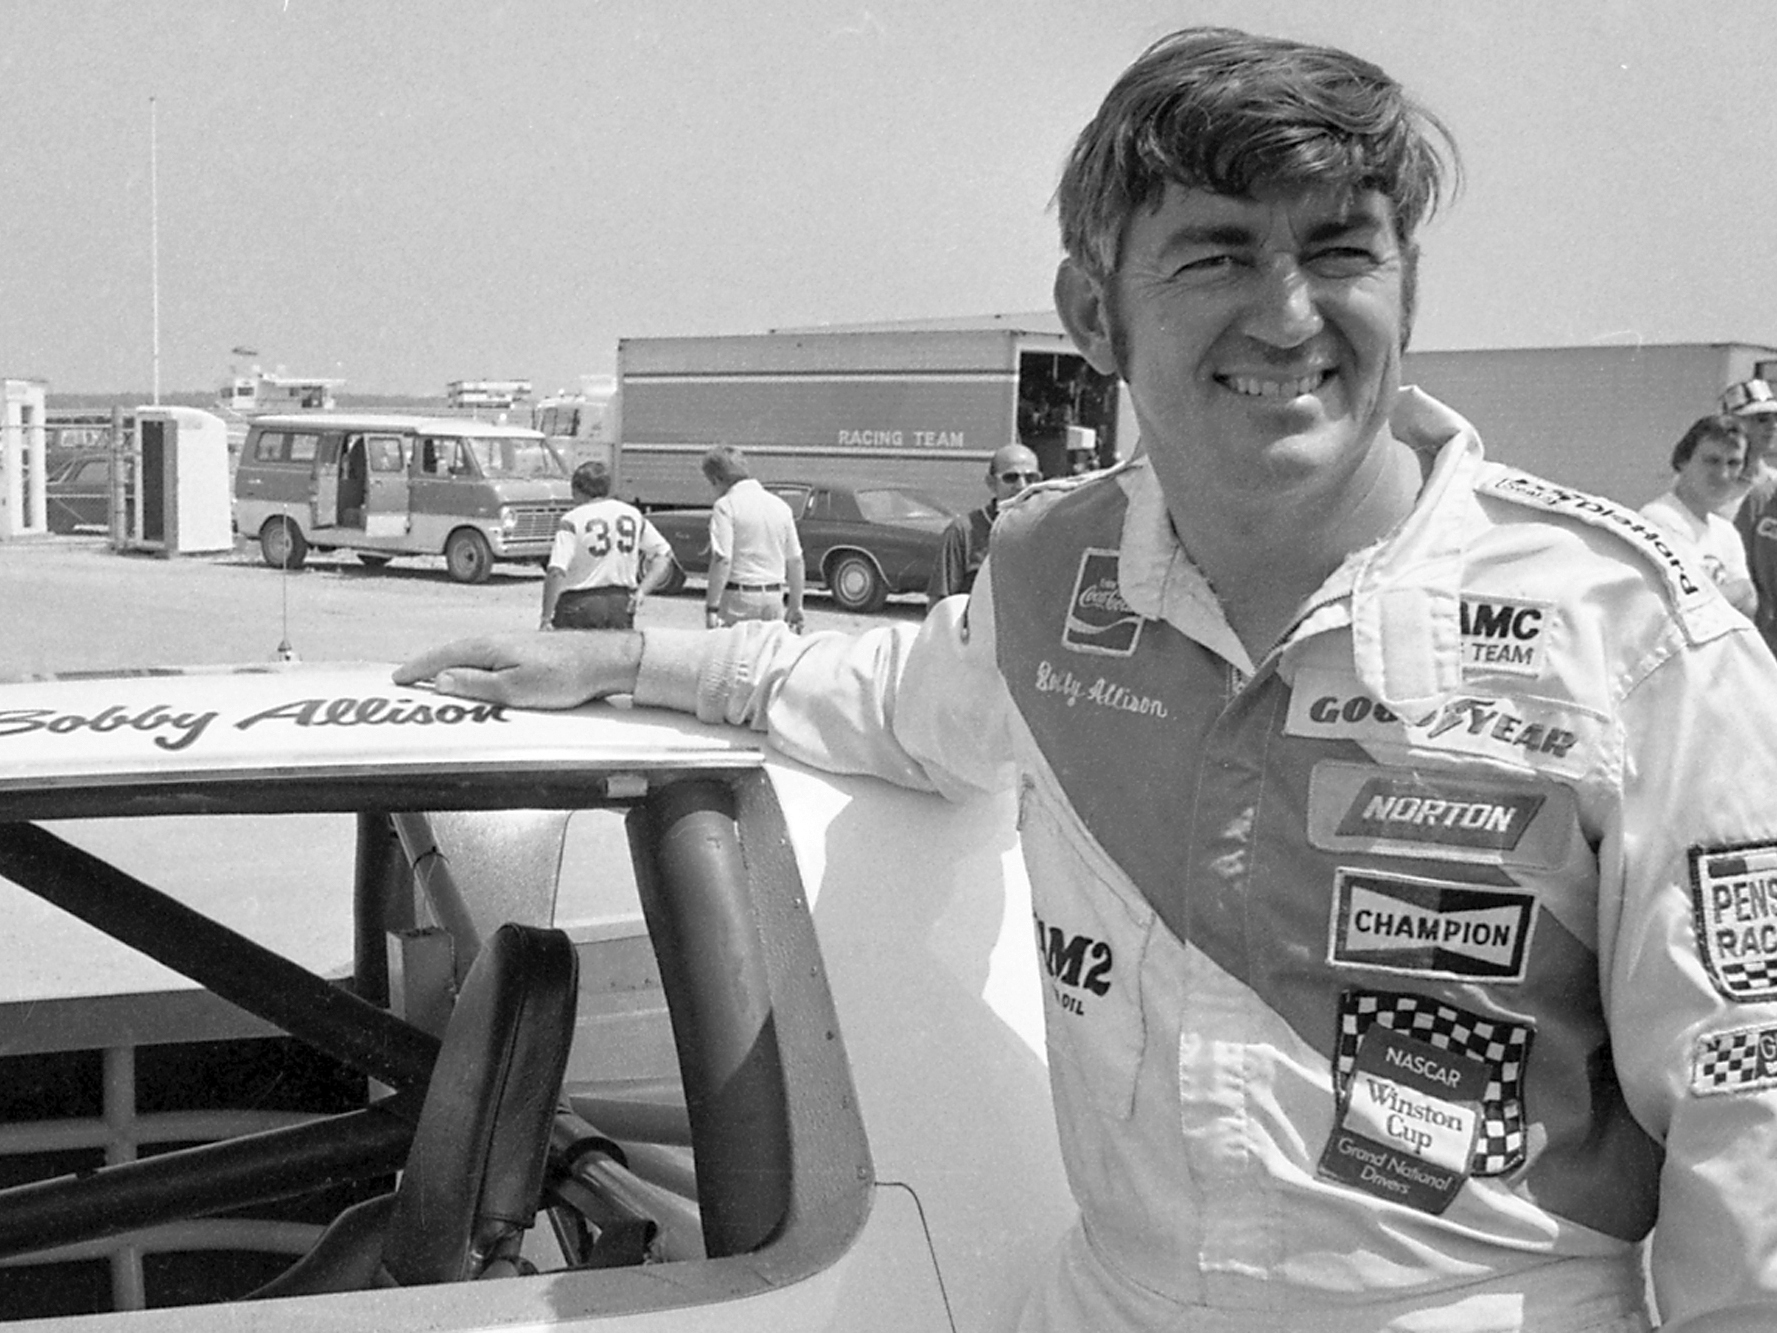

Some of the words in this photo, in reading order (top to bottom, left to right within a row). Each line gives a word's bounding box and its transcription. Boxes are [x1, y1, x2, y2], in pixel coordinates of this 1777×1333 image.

[838, 429, 903, 448] RACING
[913, 431, 964, 448] TEAM
[585, 516, 637, 557] 39
[1471, 643, 1534, 665] TEAM
[1087, 677, 1168, 719] Allison
[0, 704, 218, 751] Bobby
[234, 697, 510, 730] Allison
[1309, 695, 1578, 758] GOOYEAR
[1362, 795, 1516, 833] NORTON
[1354, 908, 1511, 947] CHAMPION
[1034, 918, 1113, 997] M2
[1062, 993, 1085, 1016] OIL
[1386, 1047, 1461, 1088] NASCAR
[1366, 1078, 1463, 1132] Winston
[1386, 1115, 1433, 1155] Cup
[1338, 1137, 1387, 1168] Grand
[1387, 1155, 1453, 1190] National
[1360, 1162, 1411, 1195] Drivers
